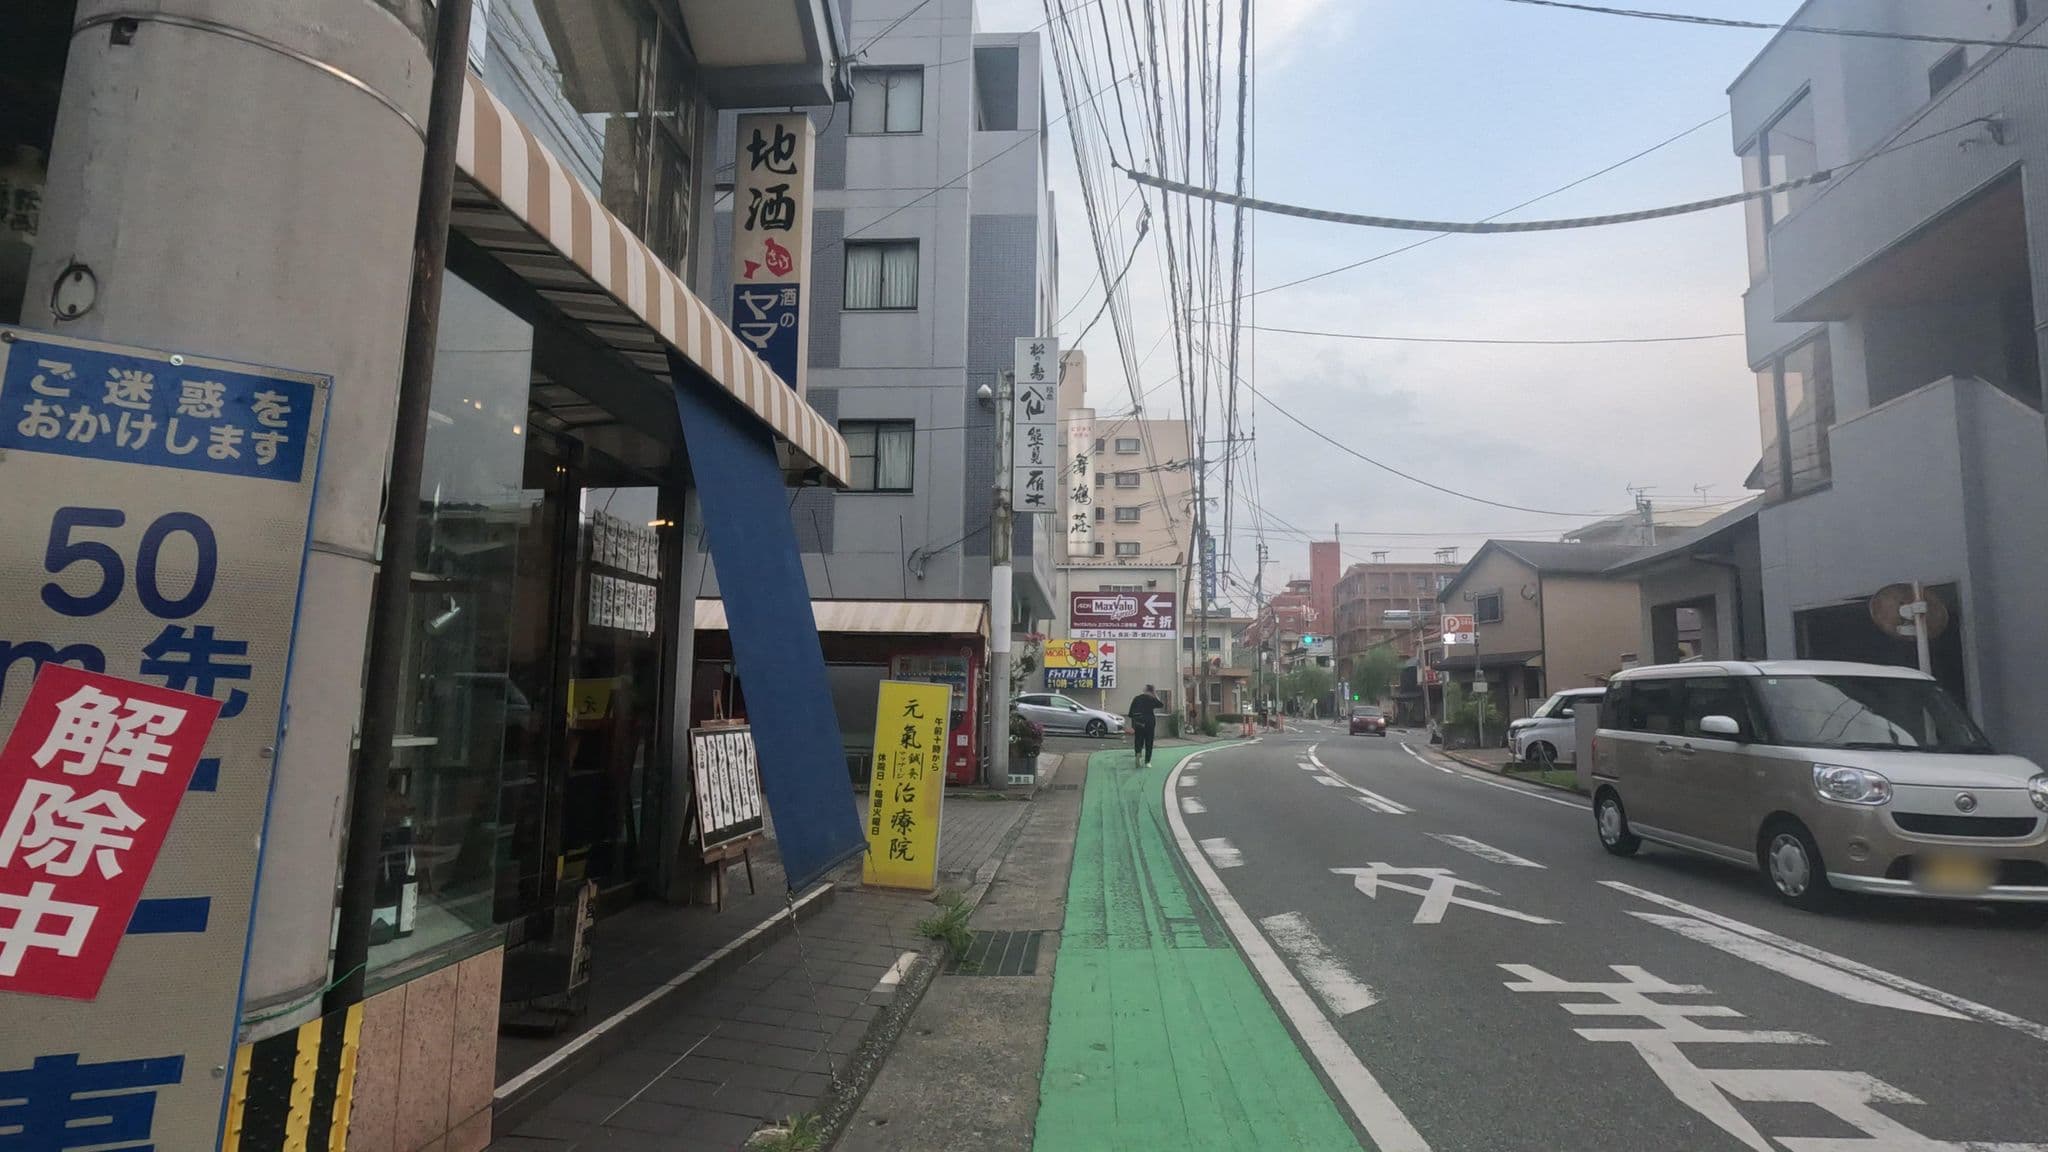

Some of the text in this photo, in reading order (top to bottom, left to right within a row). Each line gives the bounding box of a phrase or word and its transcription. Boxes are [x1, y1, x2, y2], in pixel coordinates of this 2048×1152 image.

[744, 124, 798, 231] 地酒
[739, 290, 778, 369] ヤマ
[780, 288, 797, 328] 酒の
[31, 359, 291, 427] ご迷惑を
[1020, 386, 1045, 421] 八仙
[17, 399, 289, 465] おかけします
[1025, 470, 1046, 507] 雁木
[40, 506, 218, 620] 50
[1094, 595, 1134, 611] MaxValu
[1142, 615, 1172, 629] 左折
[1100, 660, 1115, 687] 左折
[900, 699, 924, 750] 元氣
[931, 717, 943, 772] 午前十時から
[0, 685, 187, 976] 解除中
[889, 782, 916, 862] 治療院
